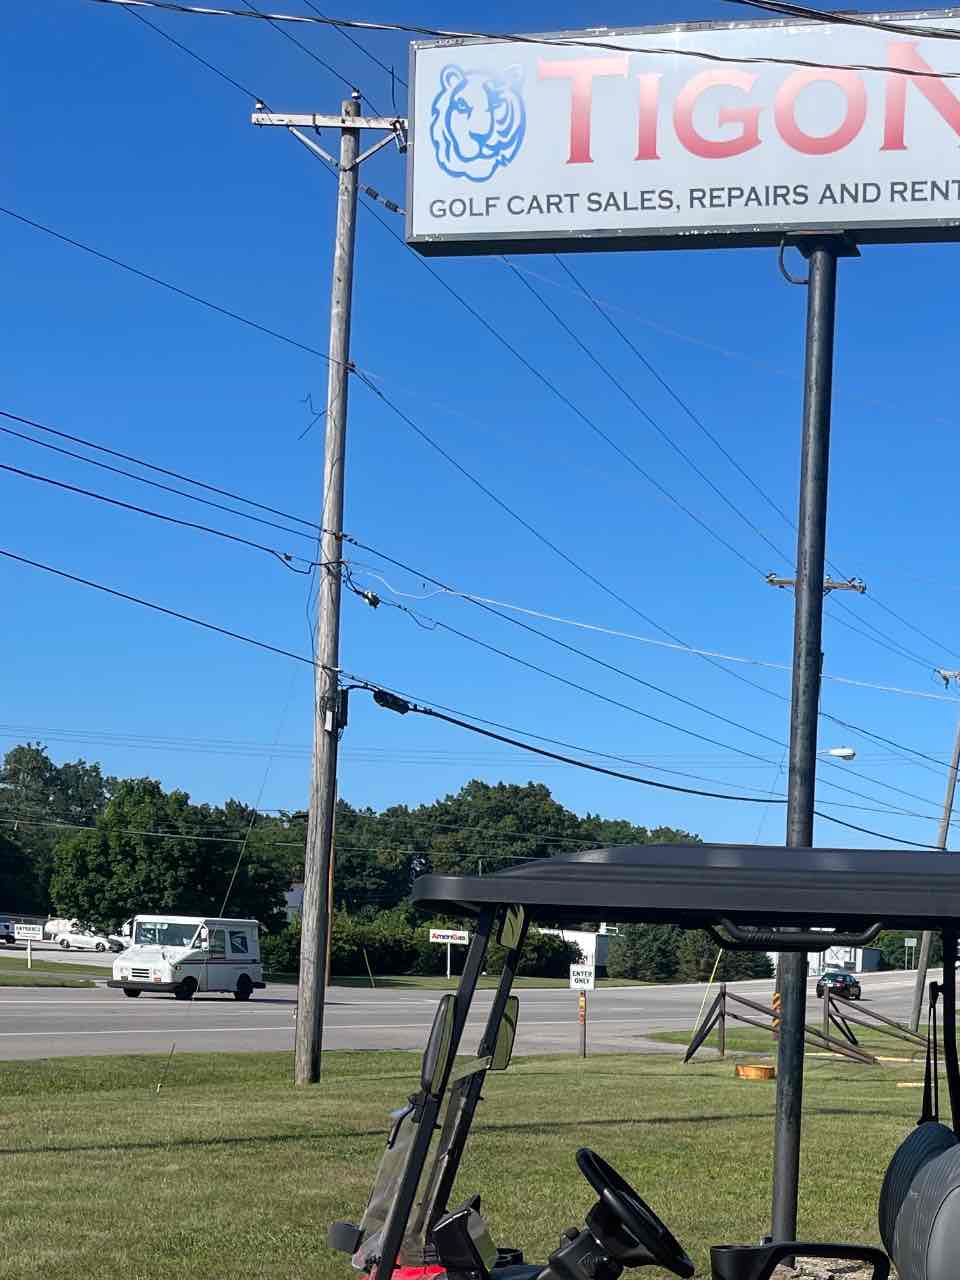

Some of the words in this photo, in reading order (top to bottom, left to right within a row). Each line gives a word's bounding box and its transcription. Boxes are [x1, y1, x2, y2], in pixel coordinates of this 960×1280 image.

[429, 196, 501, 218] GOLF
[507, 193, 580, 215] CART
[586, 189, 682, 213] SALES,
[688, 184, 810, 209] REPAIRS
[818, 181, 882, 205] AND
